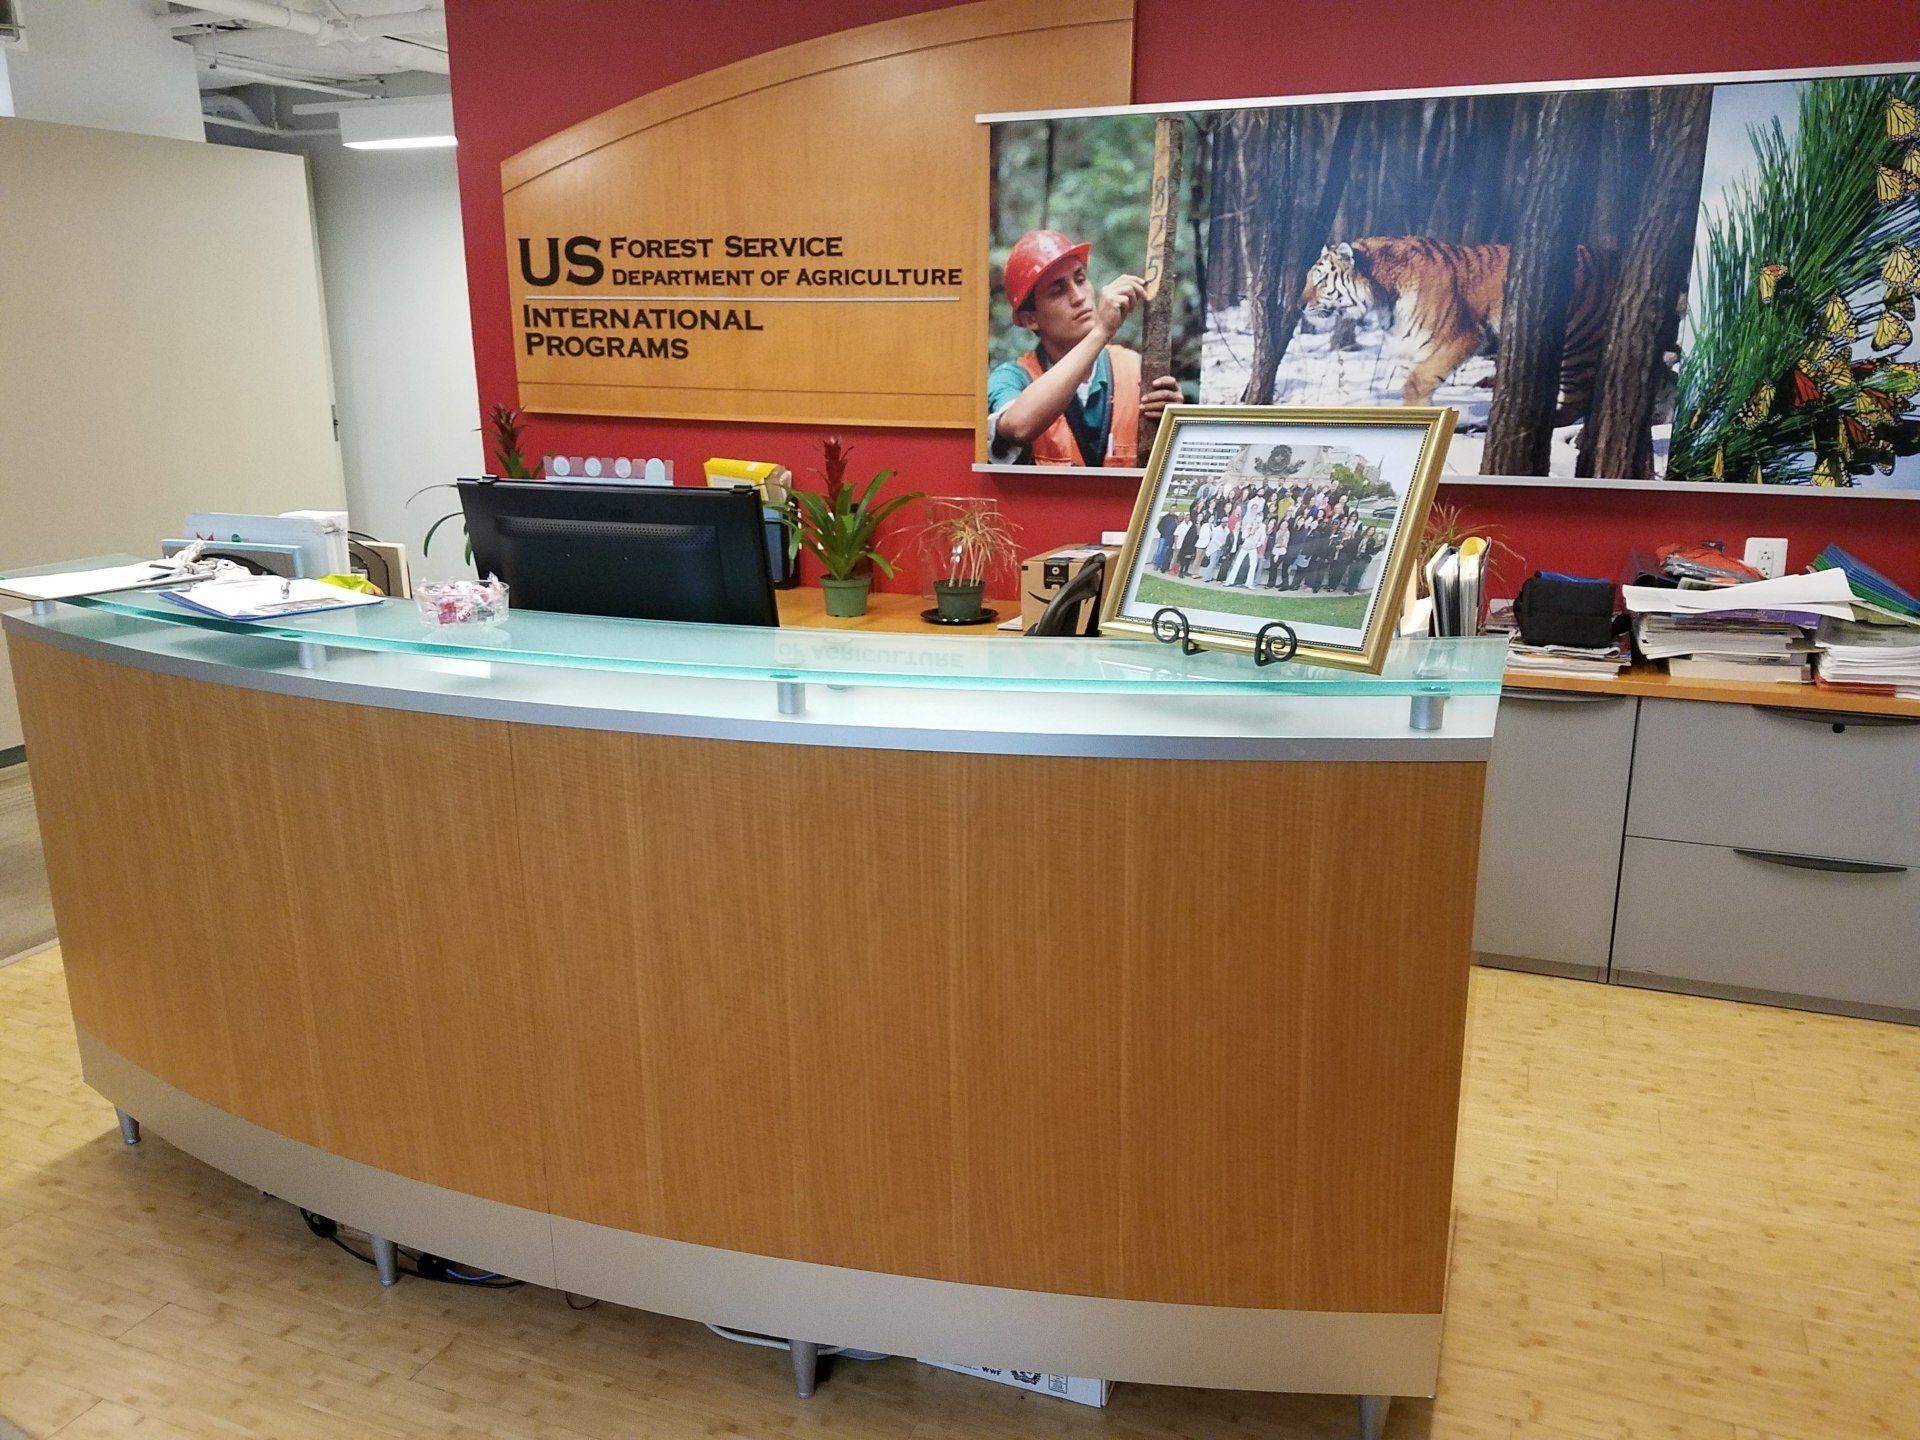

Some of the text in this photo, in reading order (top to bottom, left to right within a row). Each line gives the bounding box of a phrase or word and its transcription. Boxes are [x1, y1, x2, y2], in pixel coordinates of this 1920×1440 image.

[610, 235, 843, 259] FOREST SERVICE
[518, 236, 605, 288] US
[612, 268, 963, 287] DEPARTMENT OF AGRICULTURE
[523, 304, 763, 331] INTERNATIONAL
[525, 332, 689, 360] PROGRAMS
